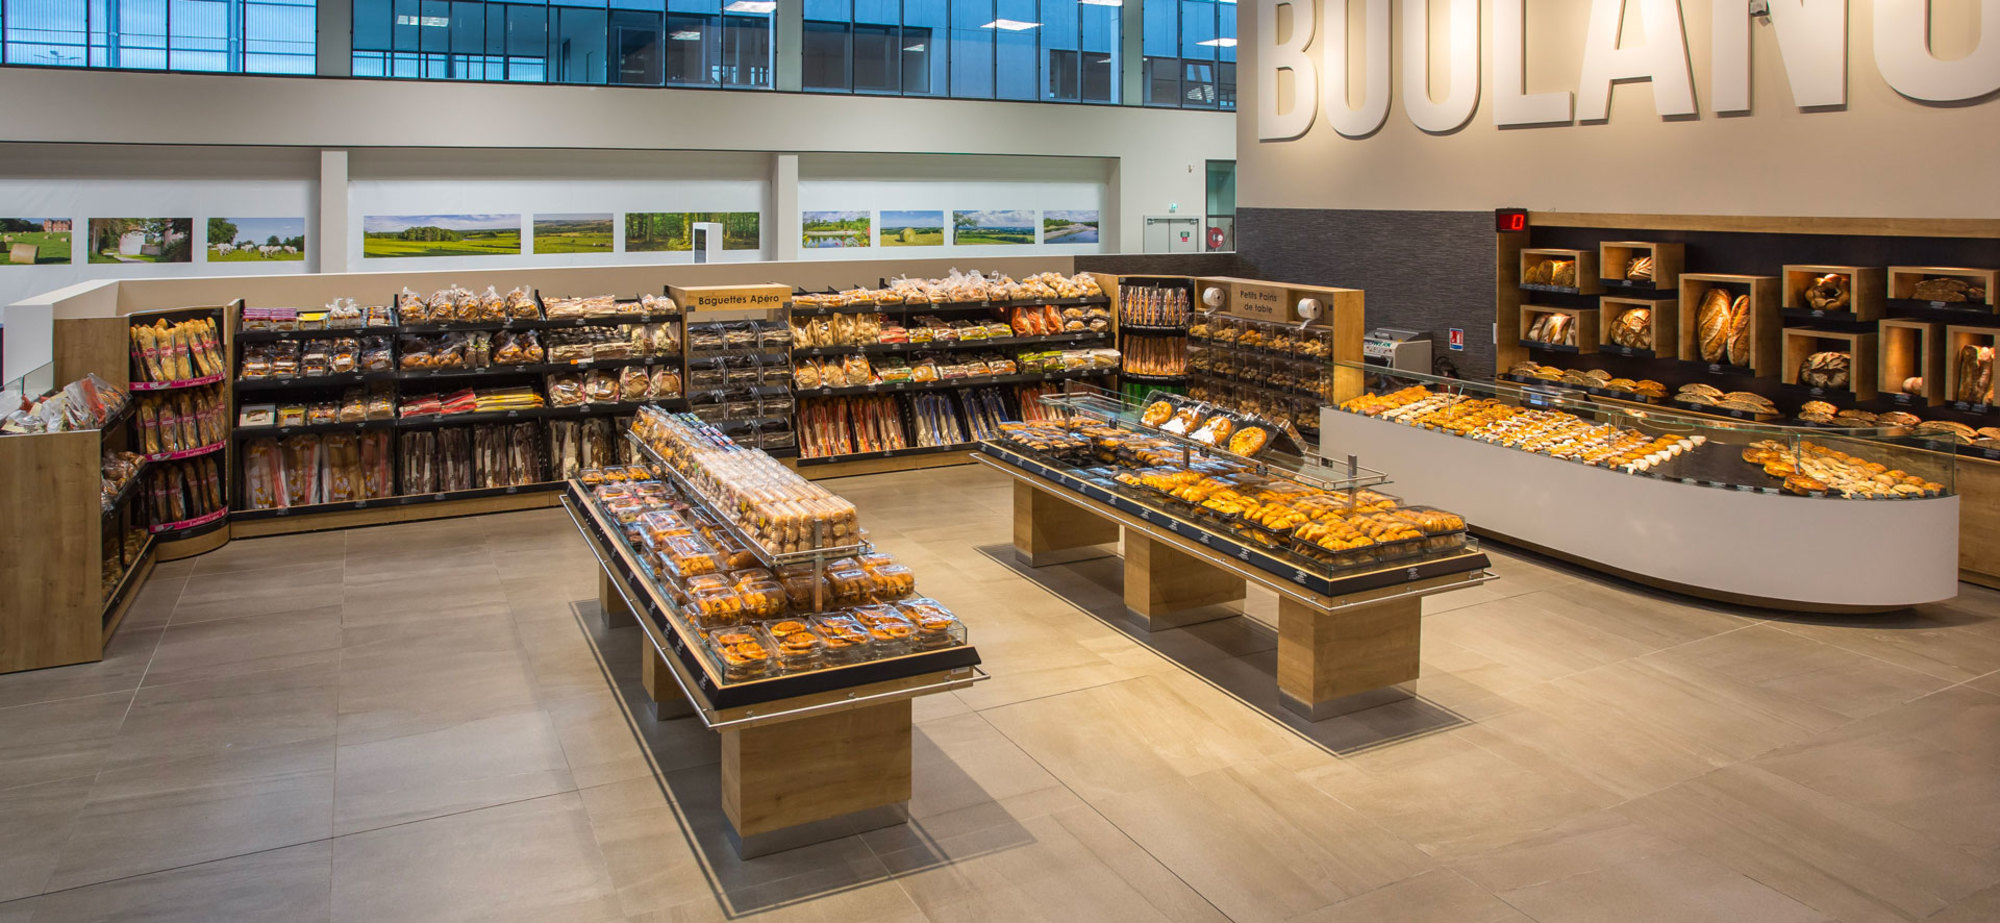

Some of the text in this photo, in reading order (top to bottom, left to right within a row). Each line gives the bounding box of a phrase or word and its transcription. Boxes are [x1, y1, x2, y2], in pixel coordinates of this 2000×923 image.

[1512, 214, 1524, 230] 0
[698, 294, 779, 306] Baguettes Apéro
[1240, 290, 1277, 302] Petits Pains
[1244, 302, 1273, 314] de table
